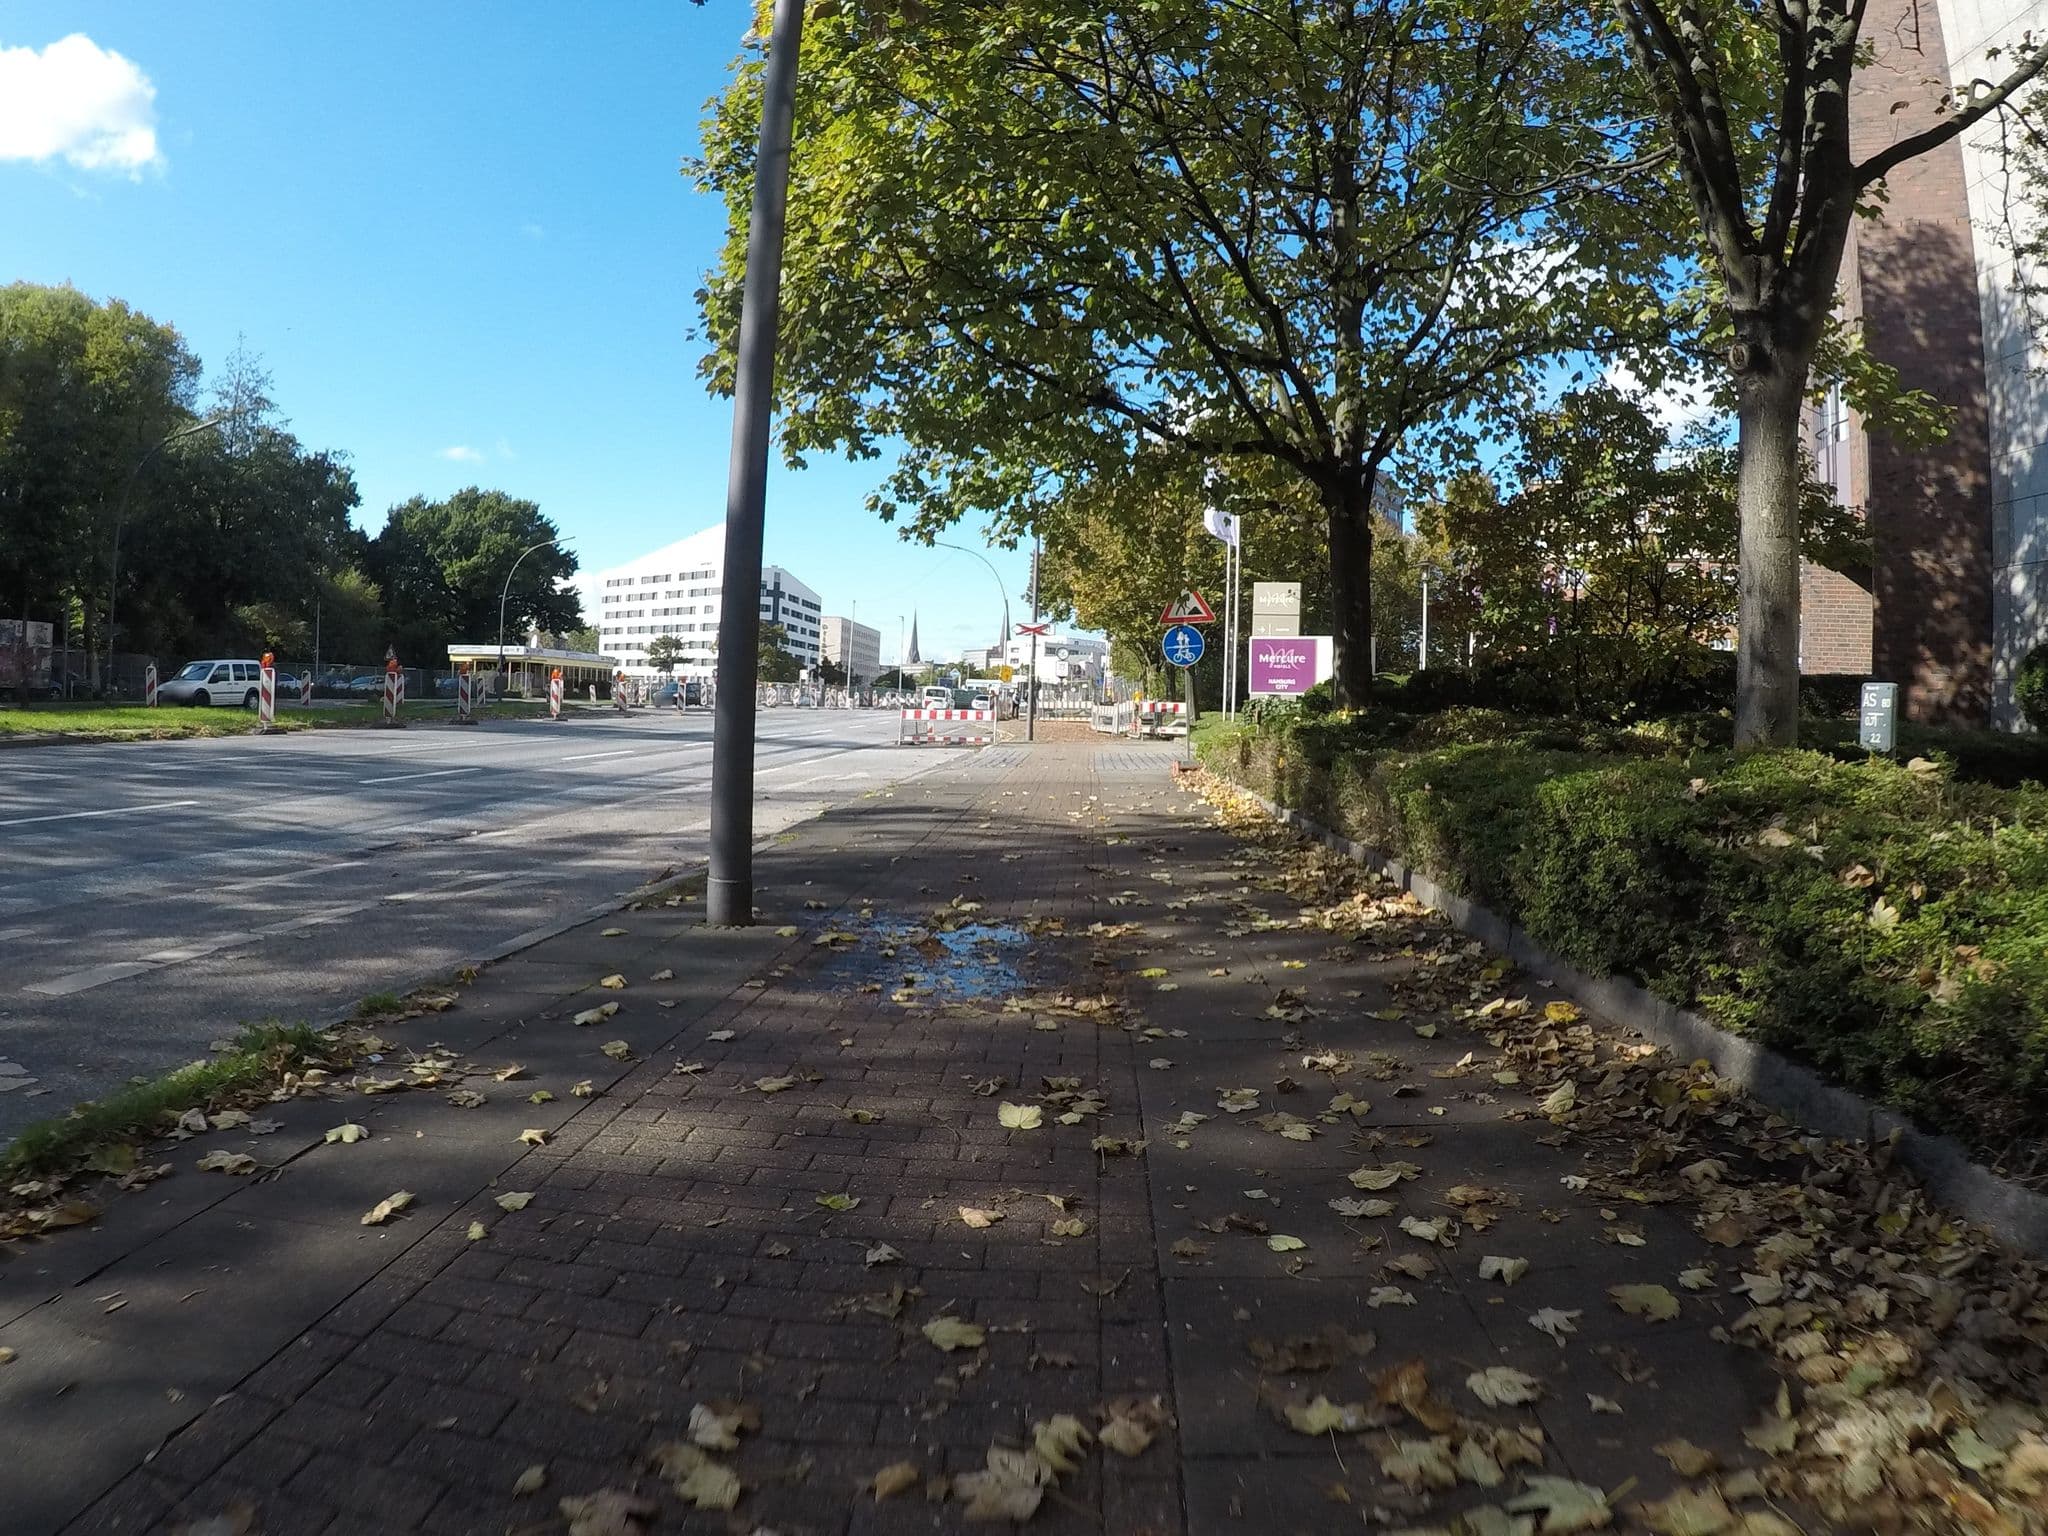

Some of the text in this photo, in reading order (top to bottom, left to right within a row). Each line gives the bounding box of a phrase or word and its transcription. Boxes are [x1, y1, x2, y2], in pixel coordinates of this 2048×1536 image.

[1258, 652, 1306, 665] Mercure
[1862, 692, 1877, 707] AS
[1869, 733, 1881, 743] 22
